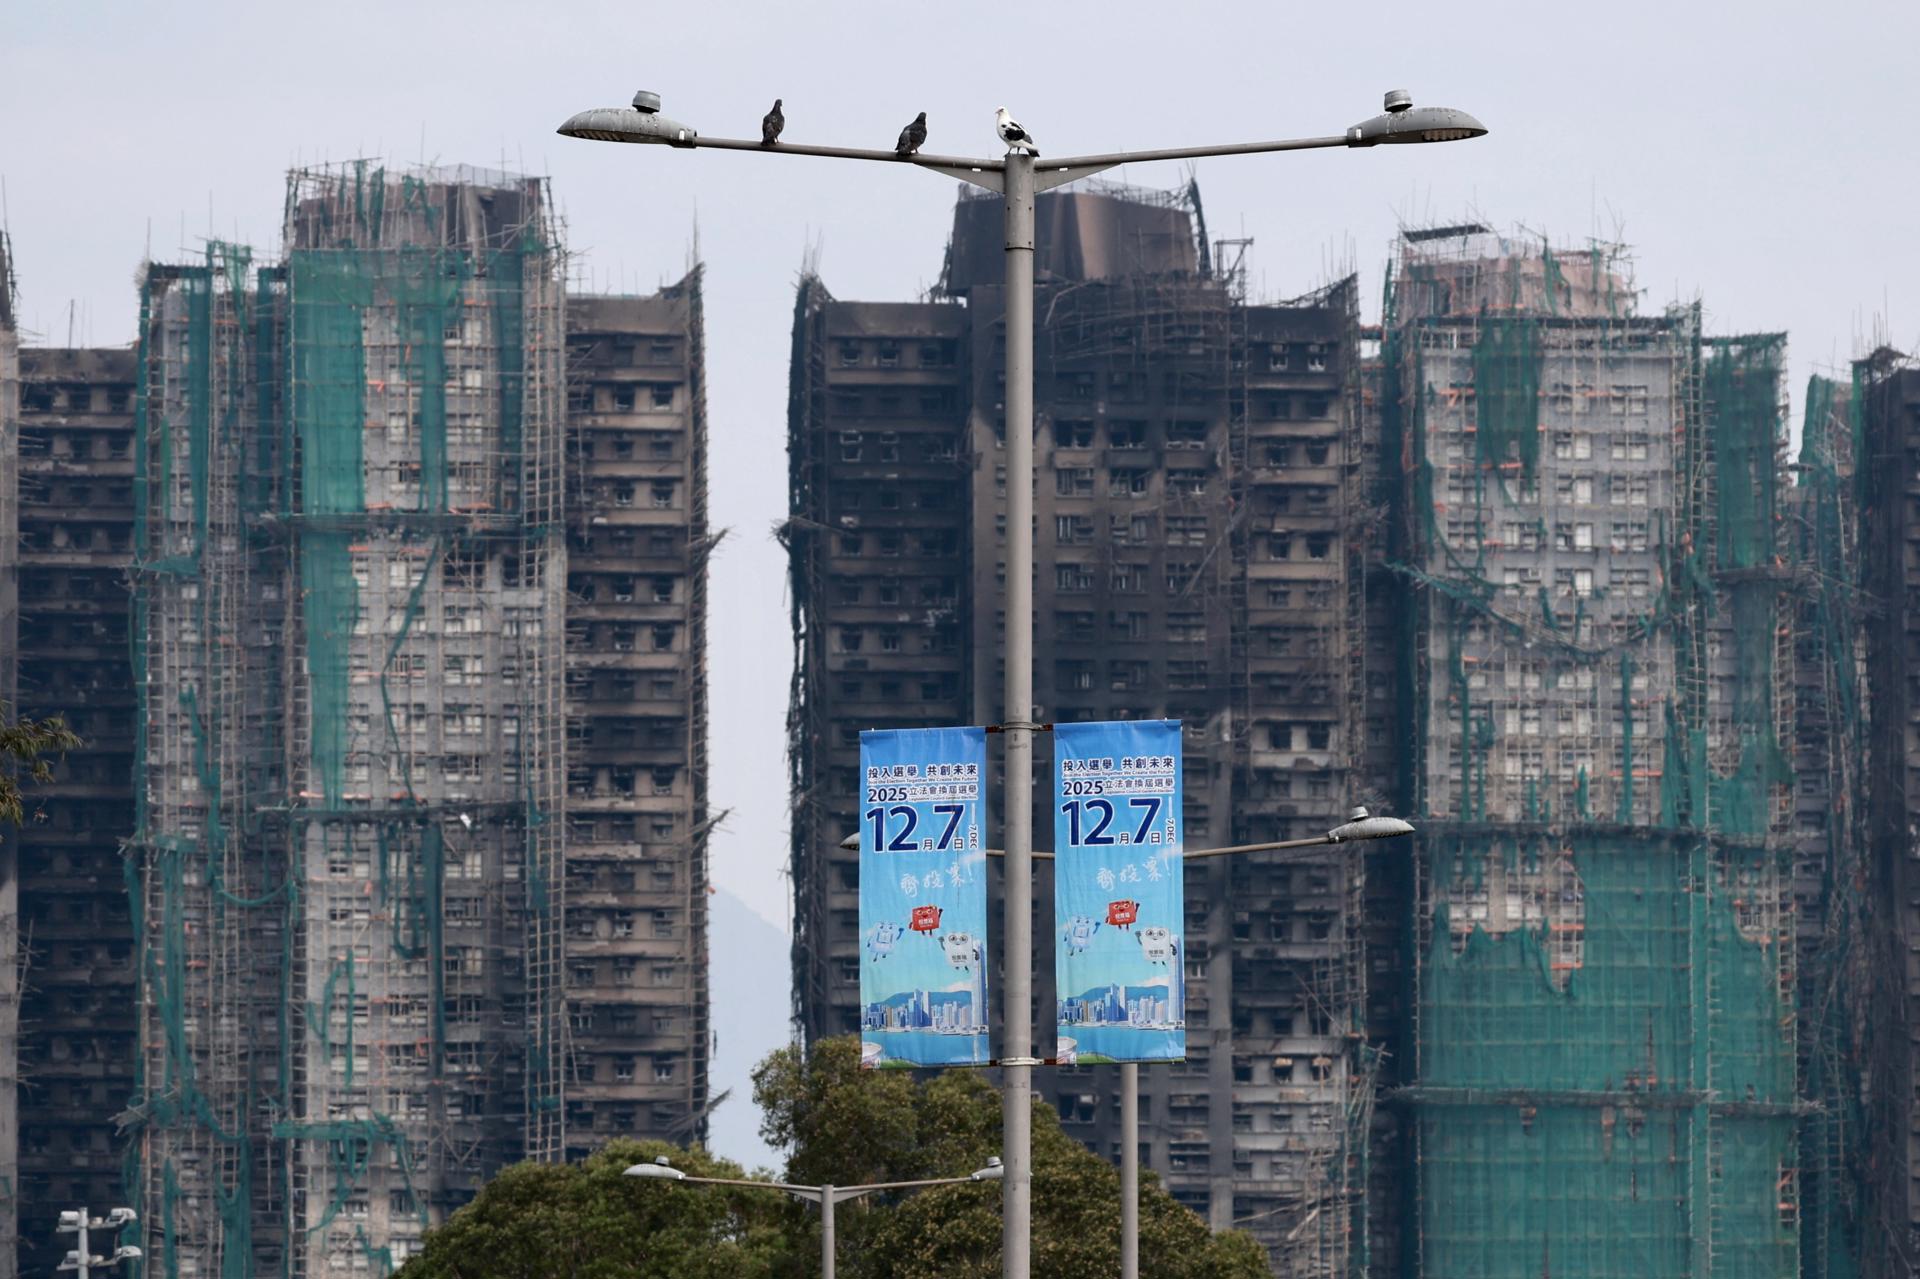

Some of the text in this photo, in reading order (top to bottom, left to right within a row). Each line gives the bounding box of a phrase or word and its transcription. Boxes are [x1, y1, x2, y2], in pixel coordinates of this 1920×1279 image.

[868, 764, 977, 779] 投入選舉 共創未來
[1063, 757, 1174, 771] 投入選舉 共創未來
[867, 787, 908, 802] 2025
[1063, 780, 1104, 796] 2025
[969, 832, 978, 849] DEC
[1167, 825, 1175, 843] DEC
